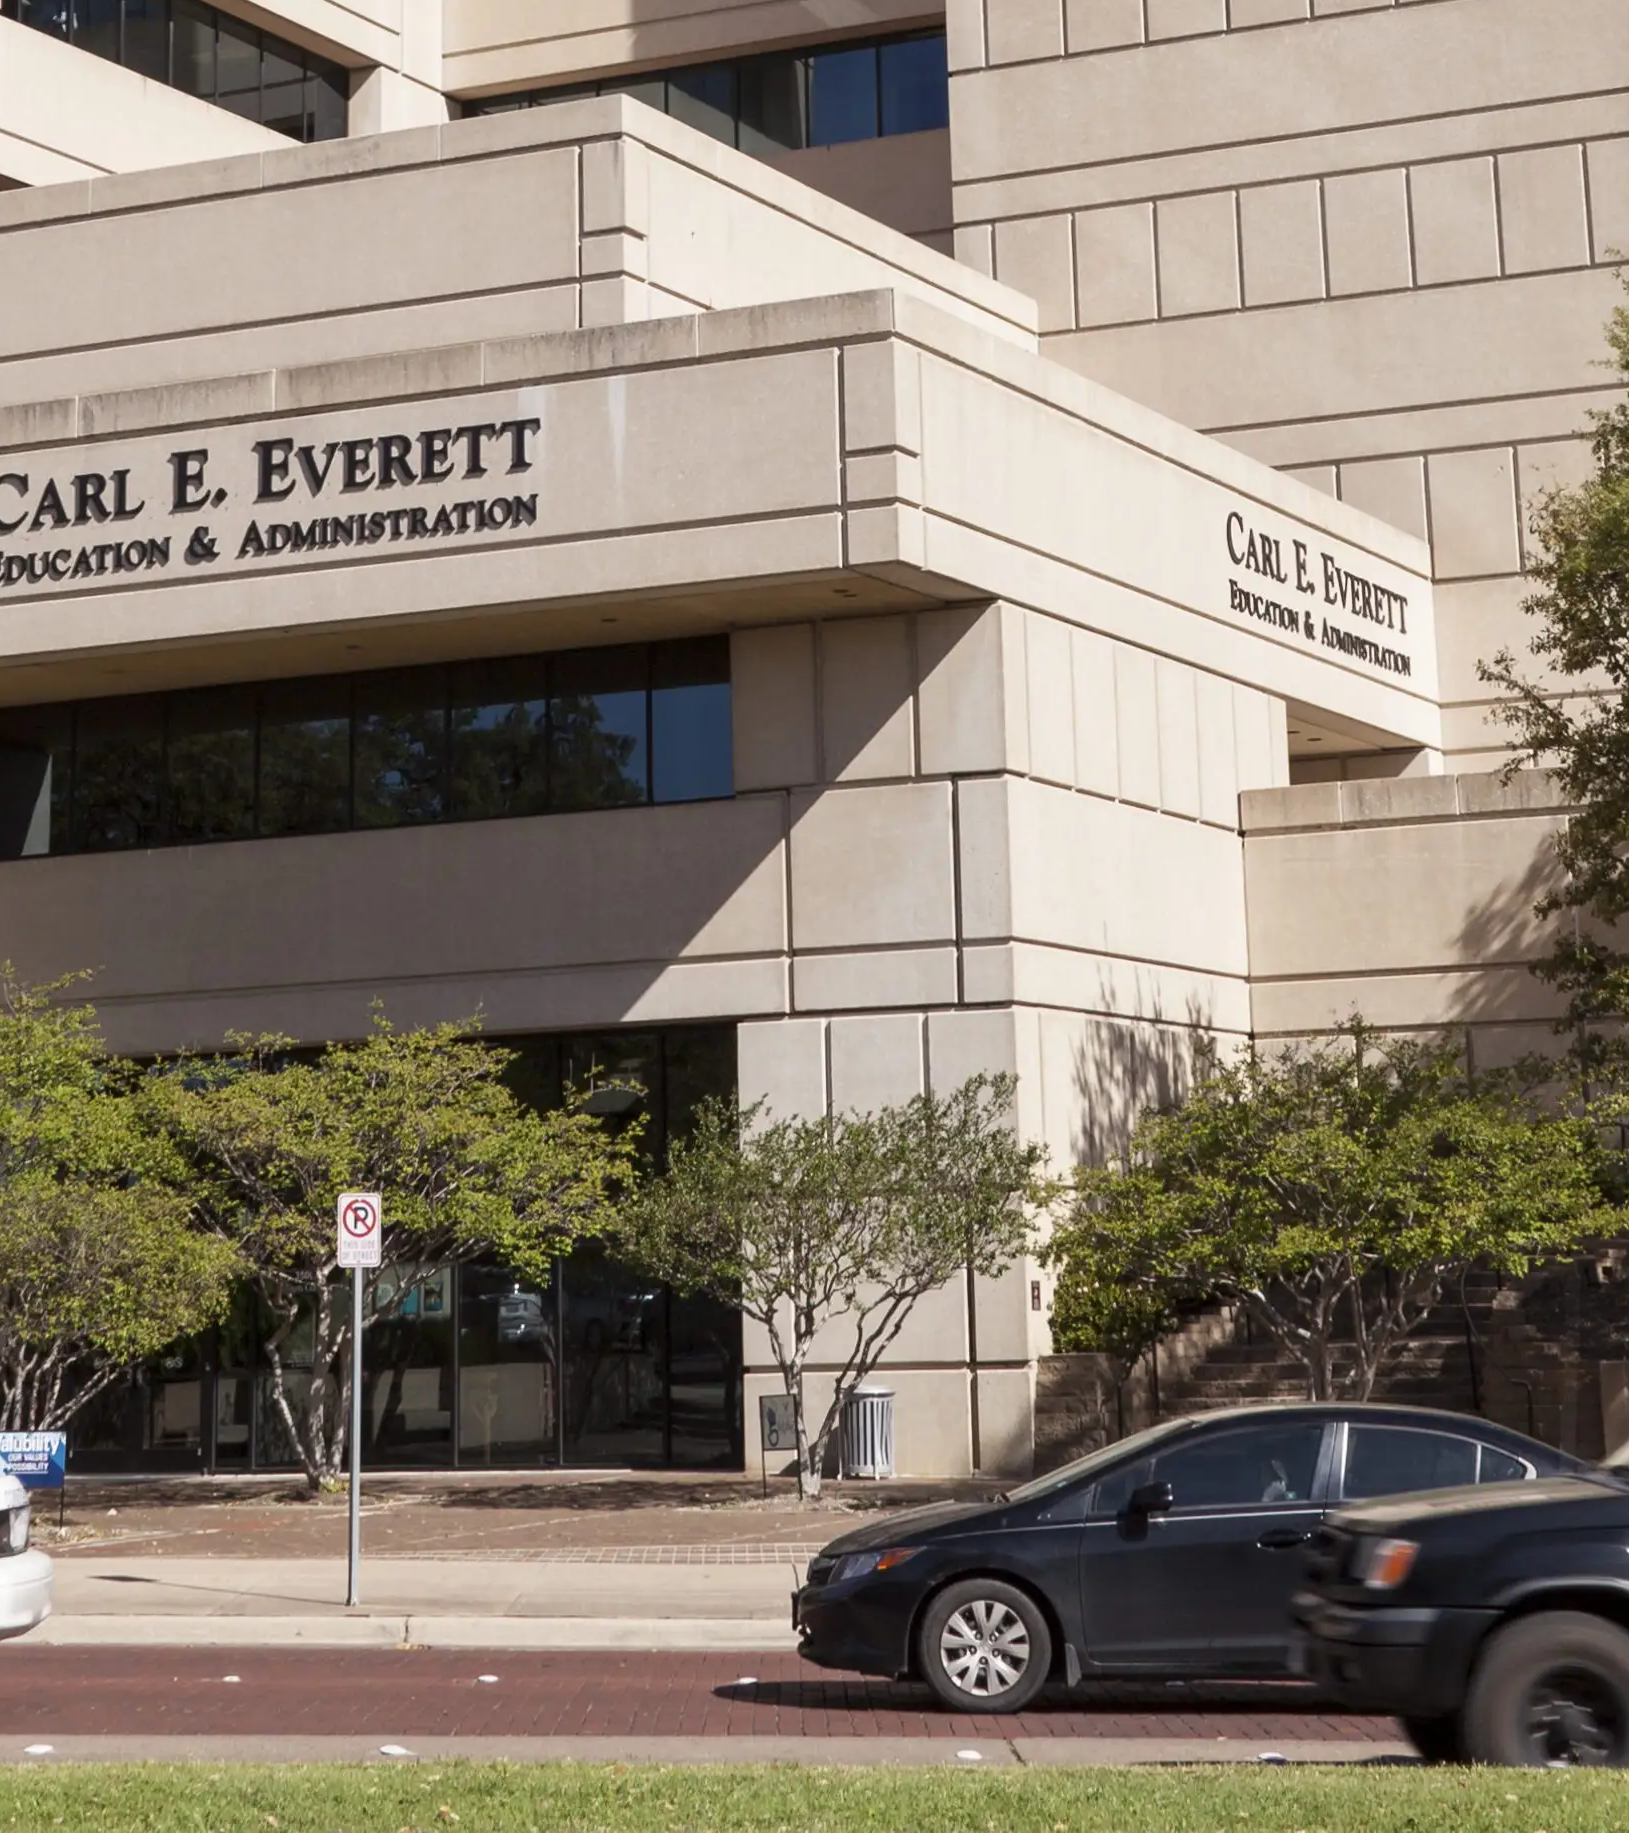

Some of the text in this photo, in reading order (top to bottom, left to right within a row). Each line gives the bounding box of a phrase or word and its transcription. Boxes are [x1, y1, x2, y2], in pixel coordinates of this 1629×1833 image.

[168, 448, 228, 516] E.
[251, 417, 541, 504] EVERETT
[183, 526, 221, 566] &
[234, 493, 539, 560] ADMINISTRATION
[1226, 511, 1408, 635] CARL E. EVERETT
[1228, 578, 1411, 677] EDUCATION & ADMINISTRATION
